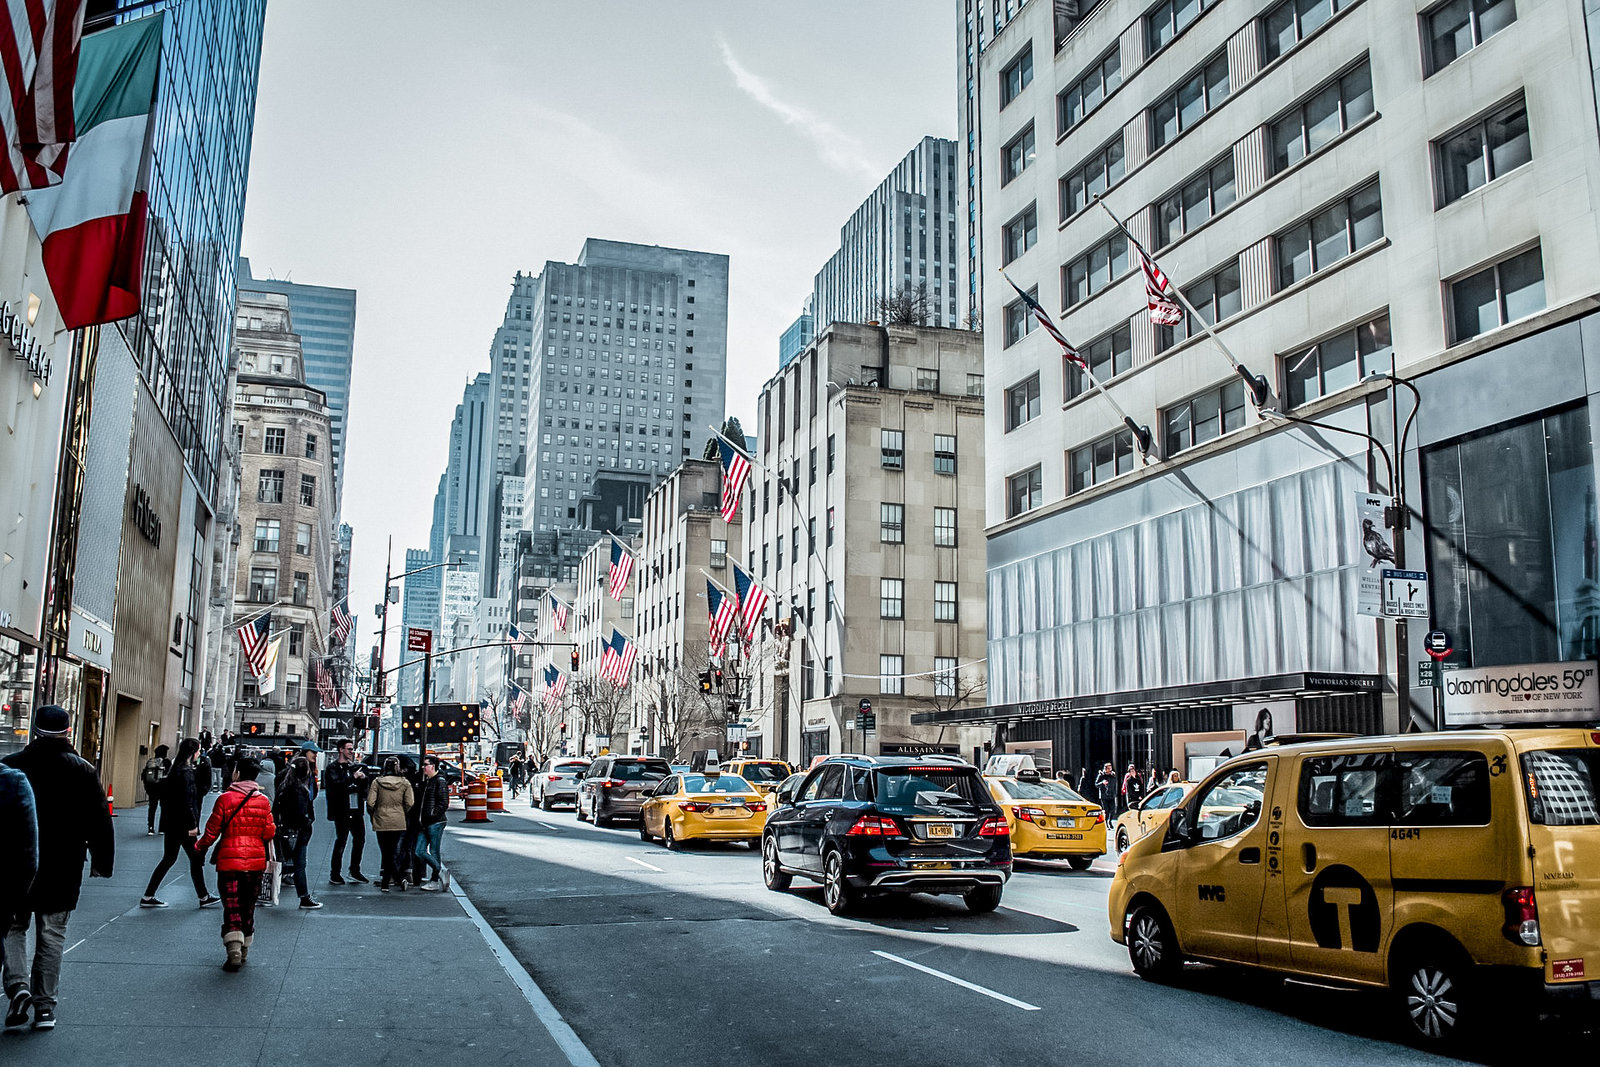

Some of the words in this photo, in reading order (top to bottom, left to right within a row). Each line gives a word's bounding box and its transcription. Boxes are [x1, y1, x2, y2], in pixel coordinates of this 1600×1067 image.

[0, 300, 54, 387] GCHAMP
[1366, 498, 1381, 506] NYC
[1309, 677, 1349, 686] VICTORIA'S
[1349, 679, 1375, 687] SECRET
[1446, 672, 1559, 697] bloomingdale's
[1511, 694, 1524, 702] THE
[1531, 693, 1542, 701] OF
[1543, 692, 1560, 700] NEW
[1561, 691, 1583, 700] YORK
[1391, 828, 1420, 841] 4G49
[1543, 871, 1575, 880] NV200
[1197, 884, 1226, 902] NYC
[1323, 886, 1362, 951] T
